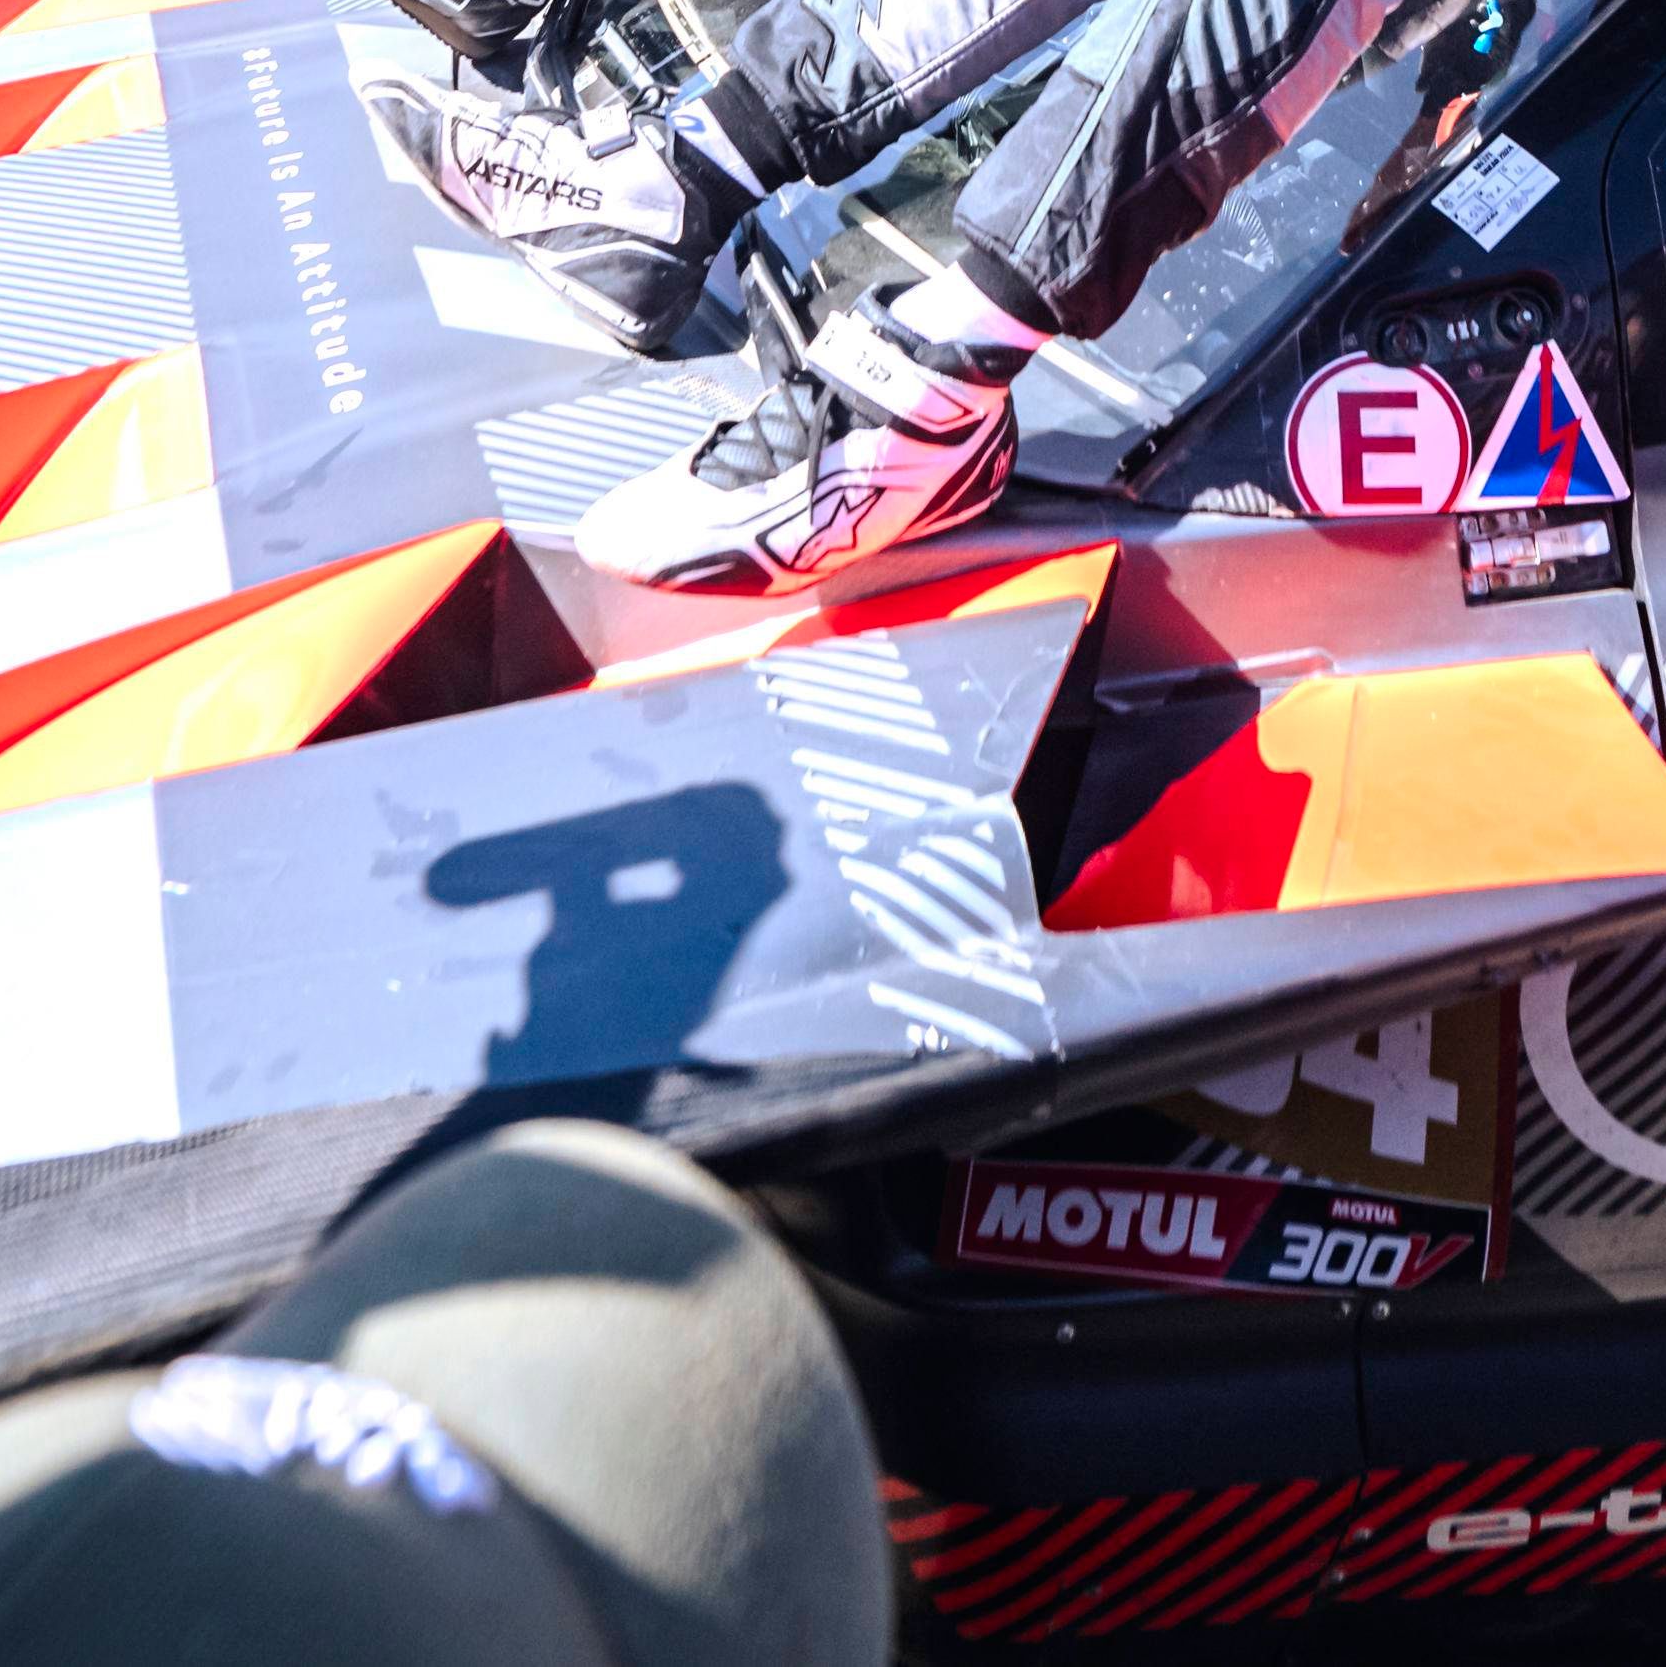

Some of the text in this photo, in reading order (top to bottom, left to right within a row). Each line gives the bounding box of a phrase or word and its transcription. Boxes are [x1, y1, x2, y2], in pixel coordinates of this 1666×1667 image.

[241, 46, 367, 415] #Future Is An Attitude
[1336, 390, 1423, 505] E
[977, 1183, 1228, 1260] MOTUL
[1332, 1199, 1399, 1225] MOTUL
[1268, 1222, 1475, 1290] 300V
